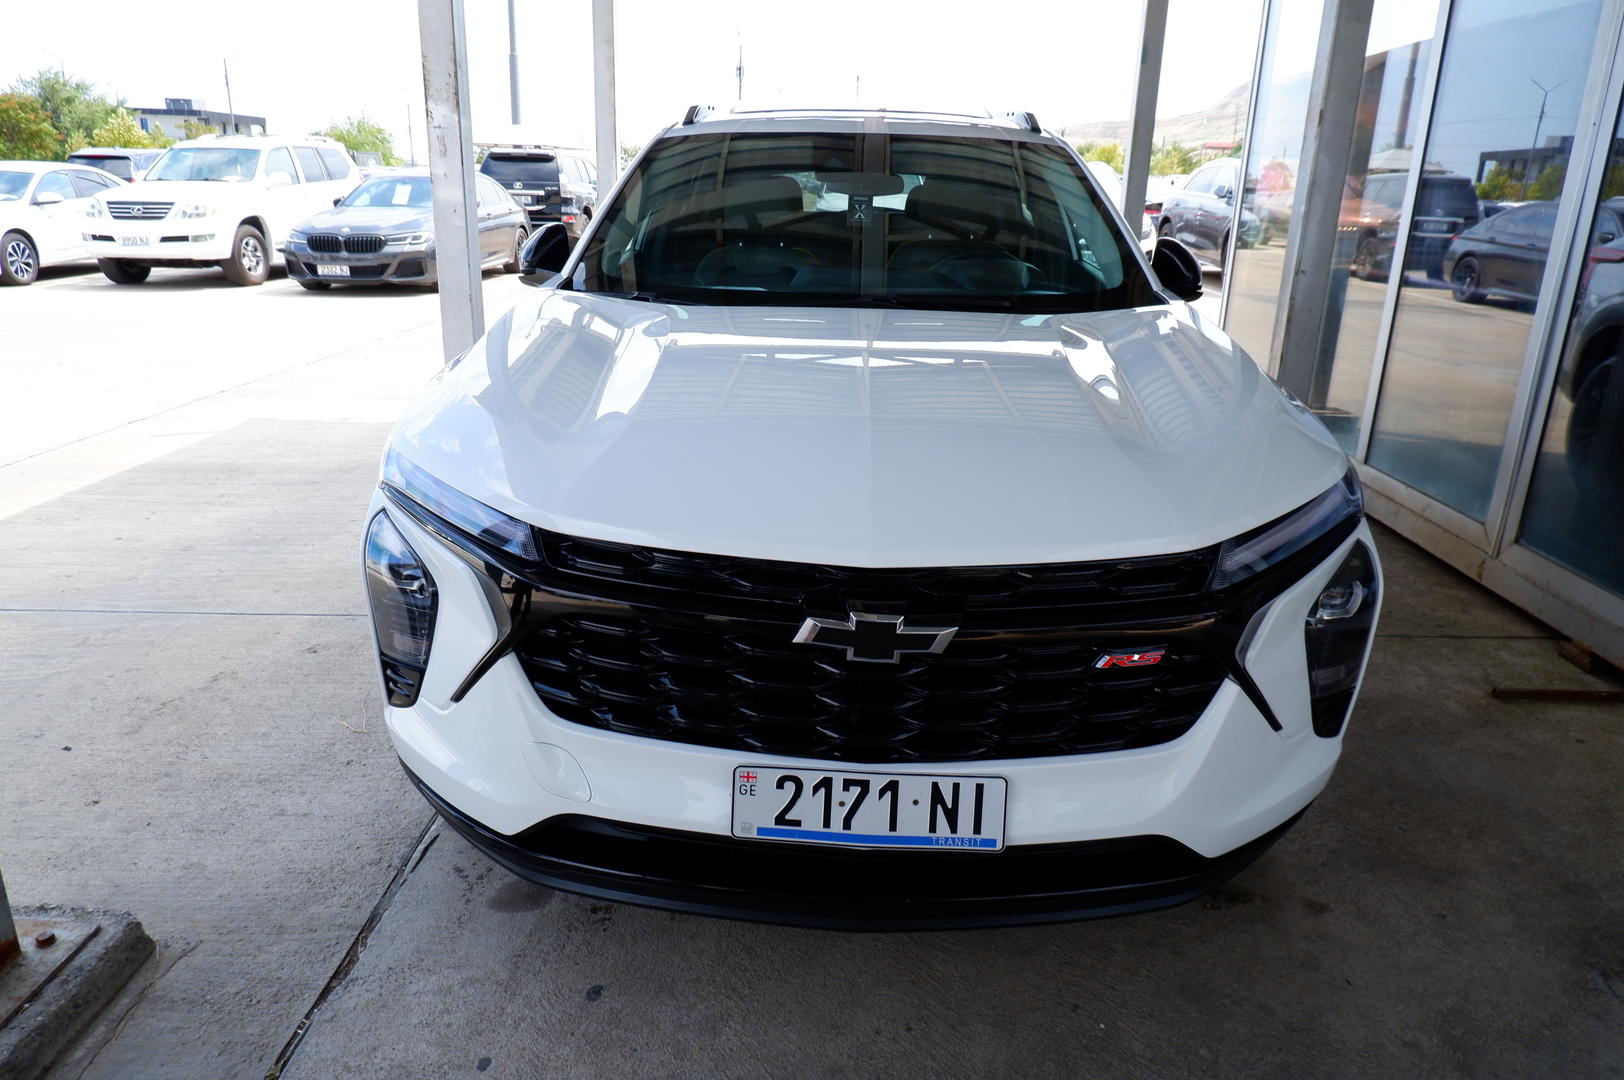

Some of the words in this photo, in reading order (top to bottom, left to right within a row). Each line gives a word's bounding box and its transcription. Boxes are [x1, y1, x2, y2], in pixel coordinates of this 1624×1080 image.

[1100, 651, 1165, 668] RS
[739, 783, 757, 796] GE
[774, 774, 900, 833] 2171
[928, 781, 984, 835] NI
[931, 836, 981, 847] TRANSIT
